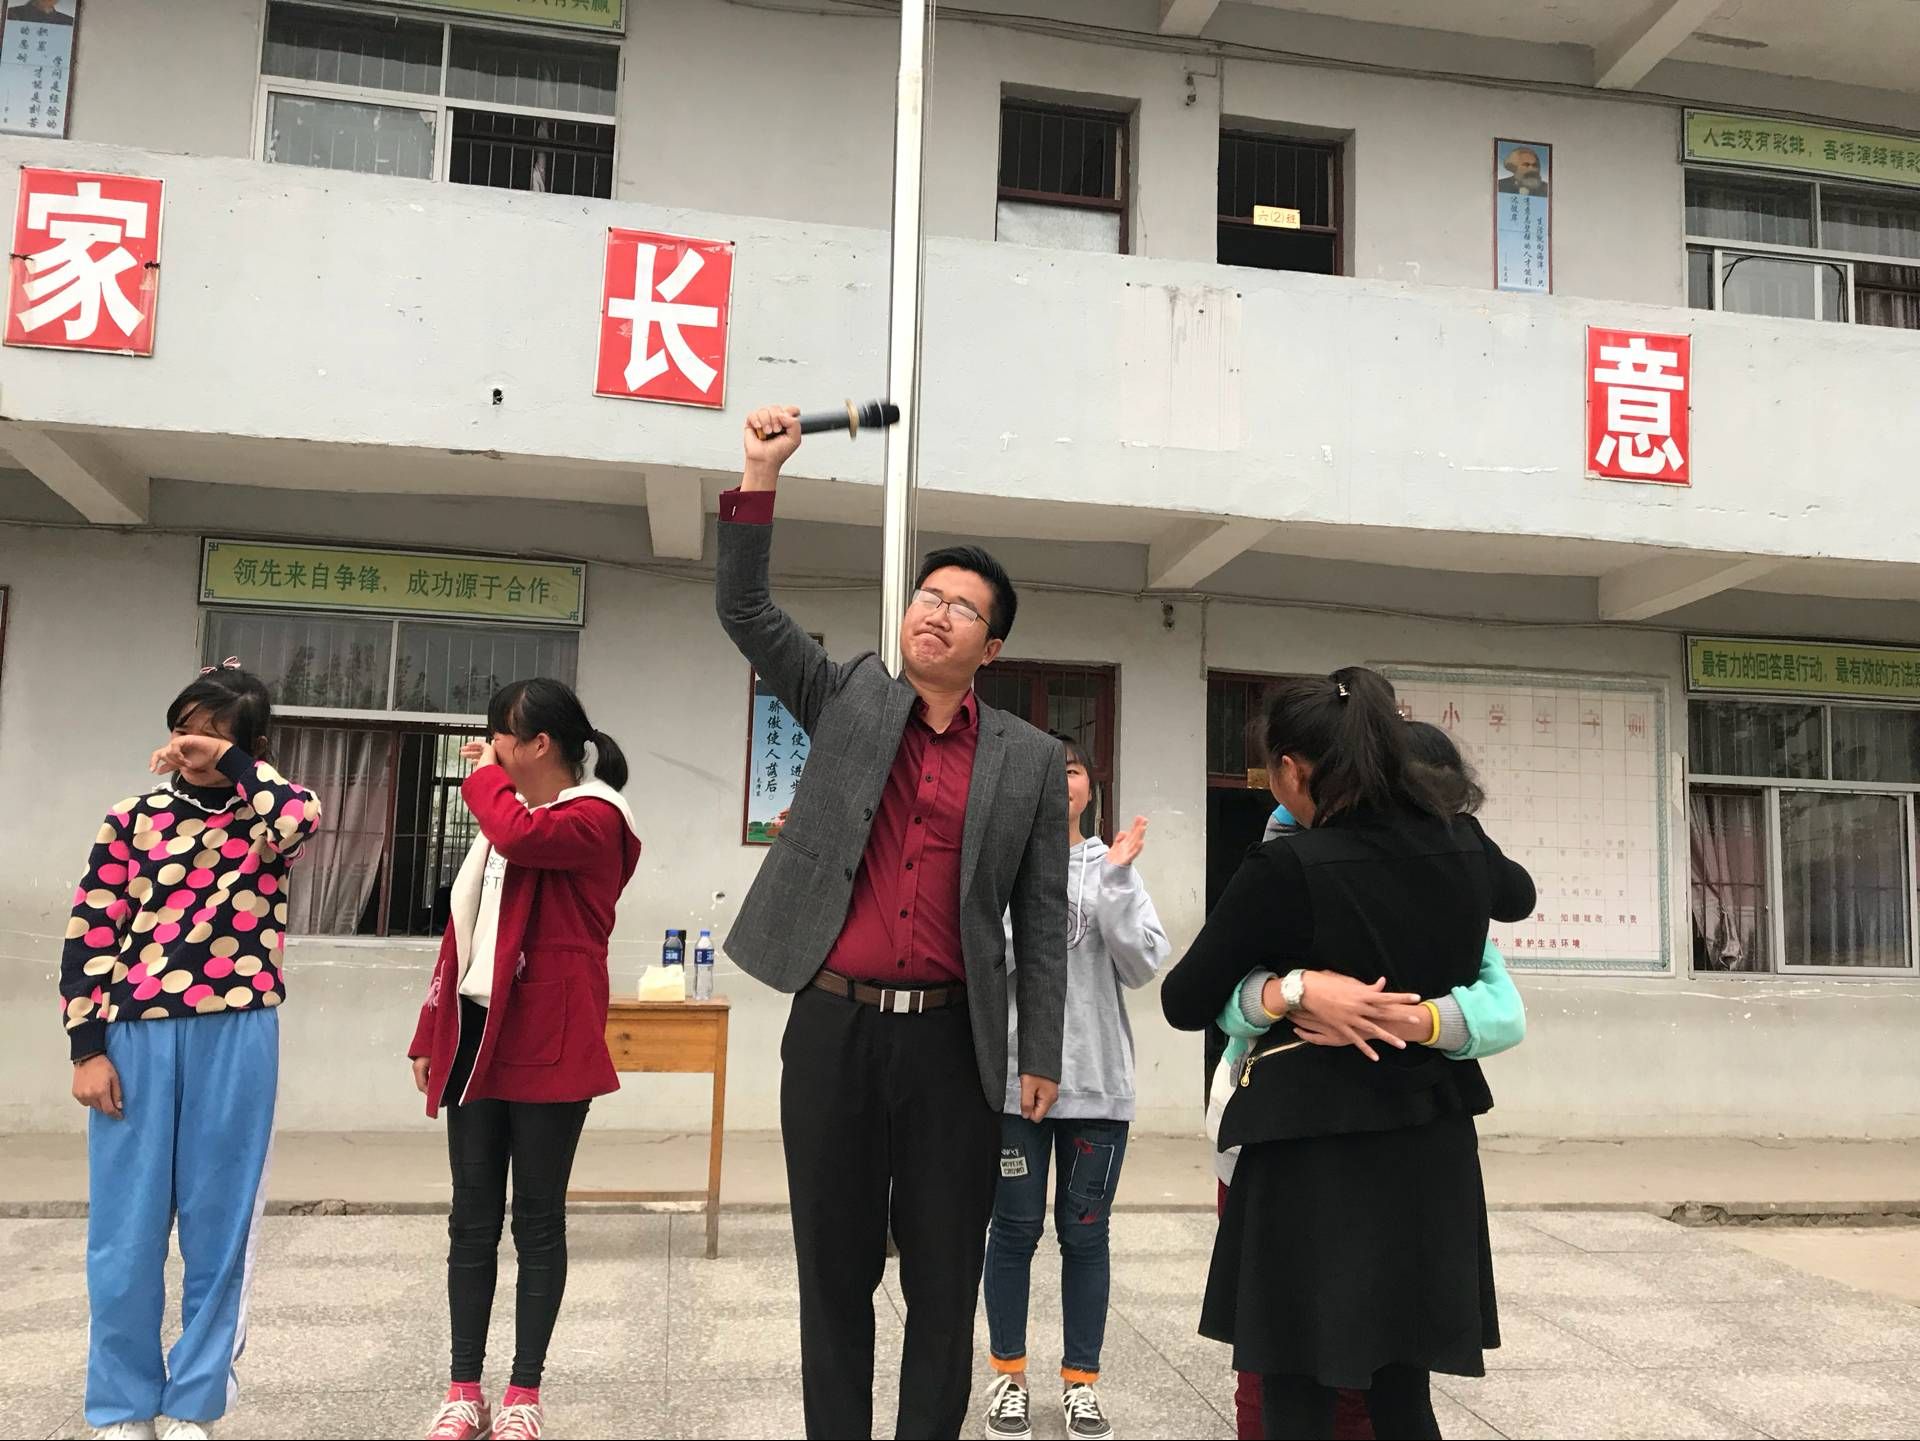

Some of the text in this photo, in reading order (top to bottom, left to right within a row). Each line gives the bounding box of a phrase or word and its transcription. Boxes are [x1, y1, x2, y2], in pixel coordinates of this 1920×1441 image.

[16, 182, 148, 340] 家
[608, 243, 719, 394] 长
[1594, 338, 1684, 475] 意
